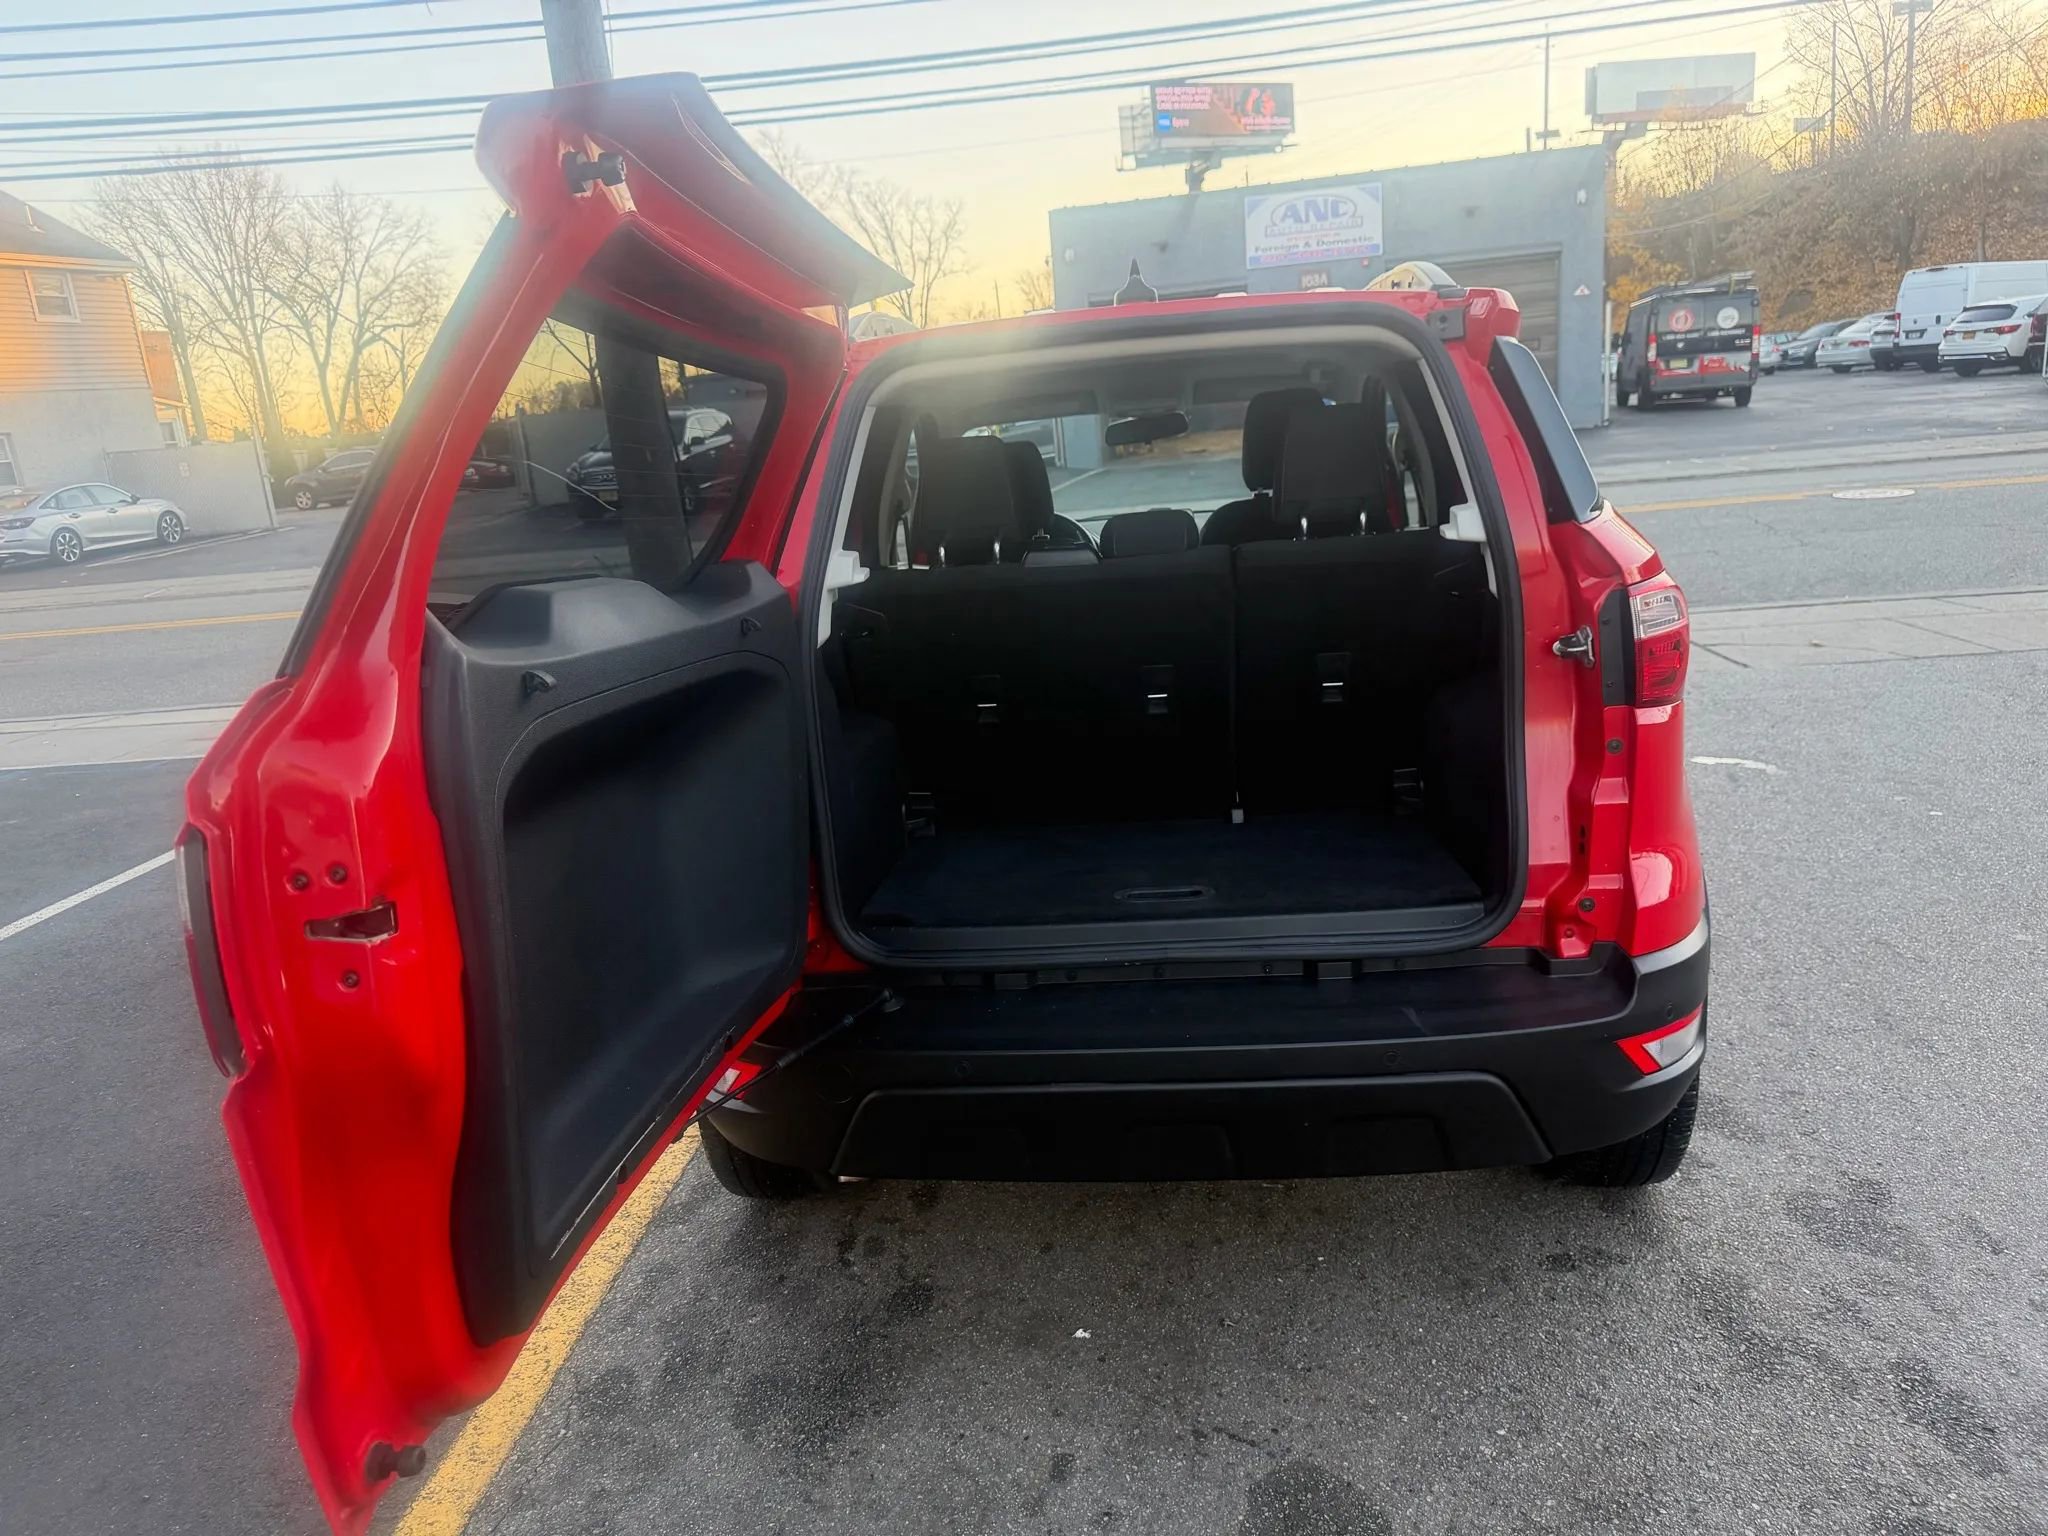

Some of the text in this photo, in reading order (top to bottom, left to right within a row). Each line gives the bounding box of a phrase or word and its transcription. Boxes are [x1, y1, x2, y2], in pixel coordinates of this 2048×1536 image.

[1254, 242, 1299, 254] Foreign
[1302, 241, 1311, 249] &
[1316, 234, 1375, 247] Domestic
